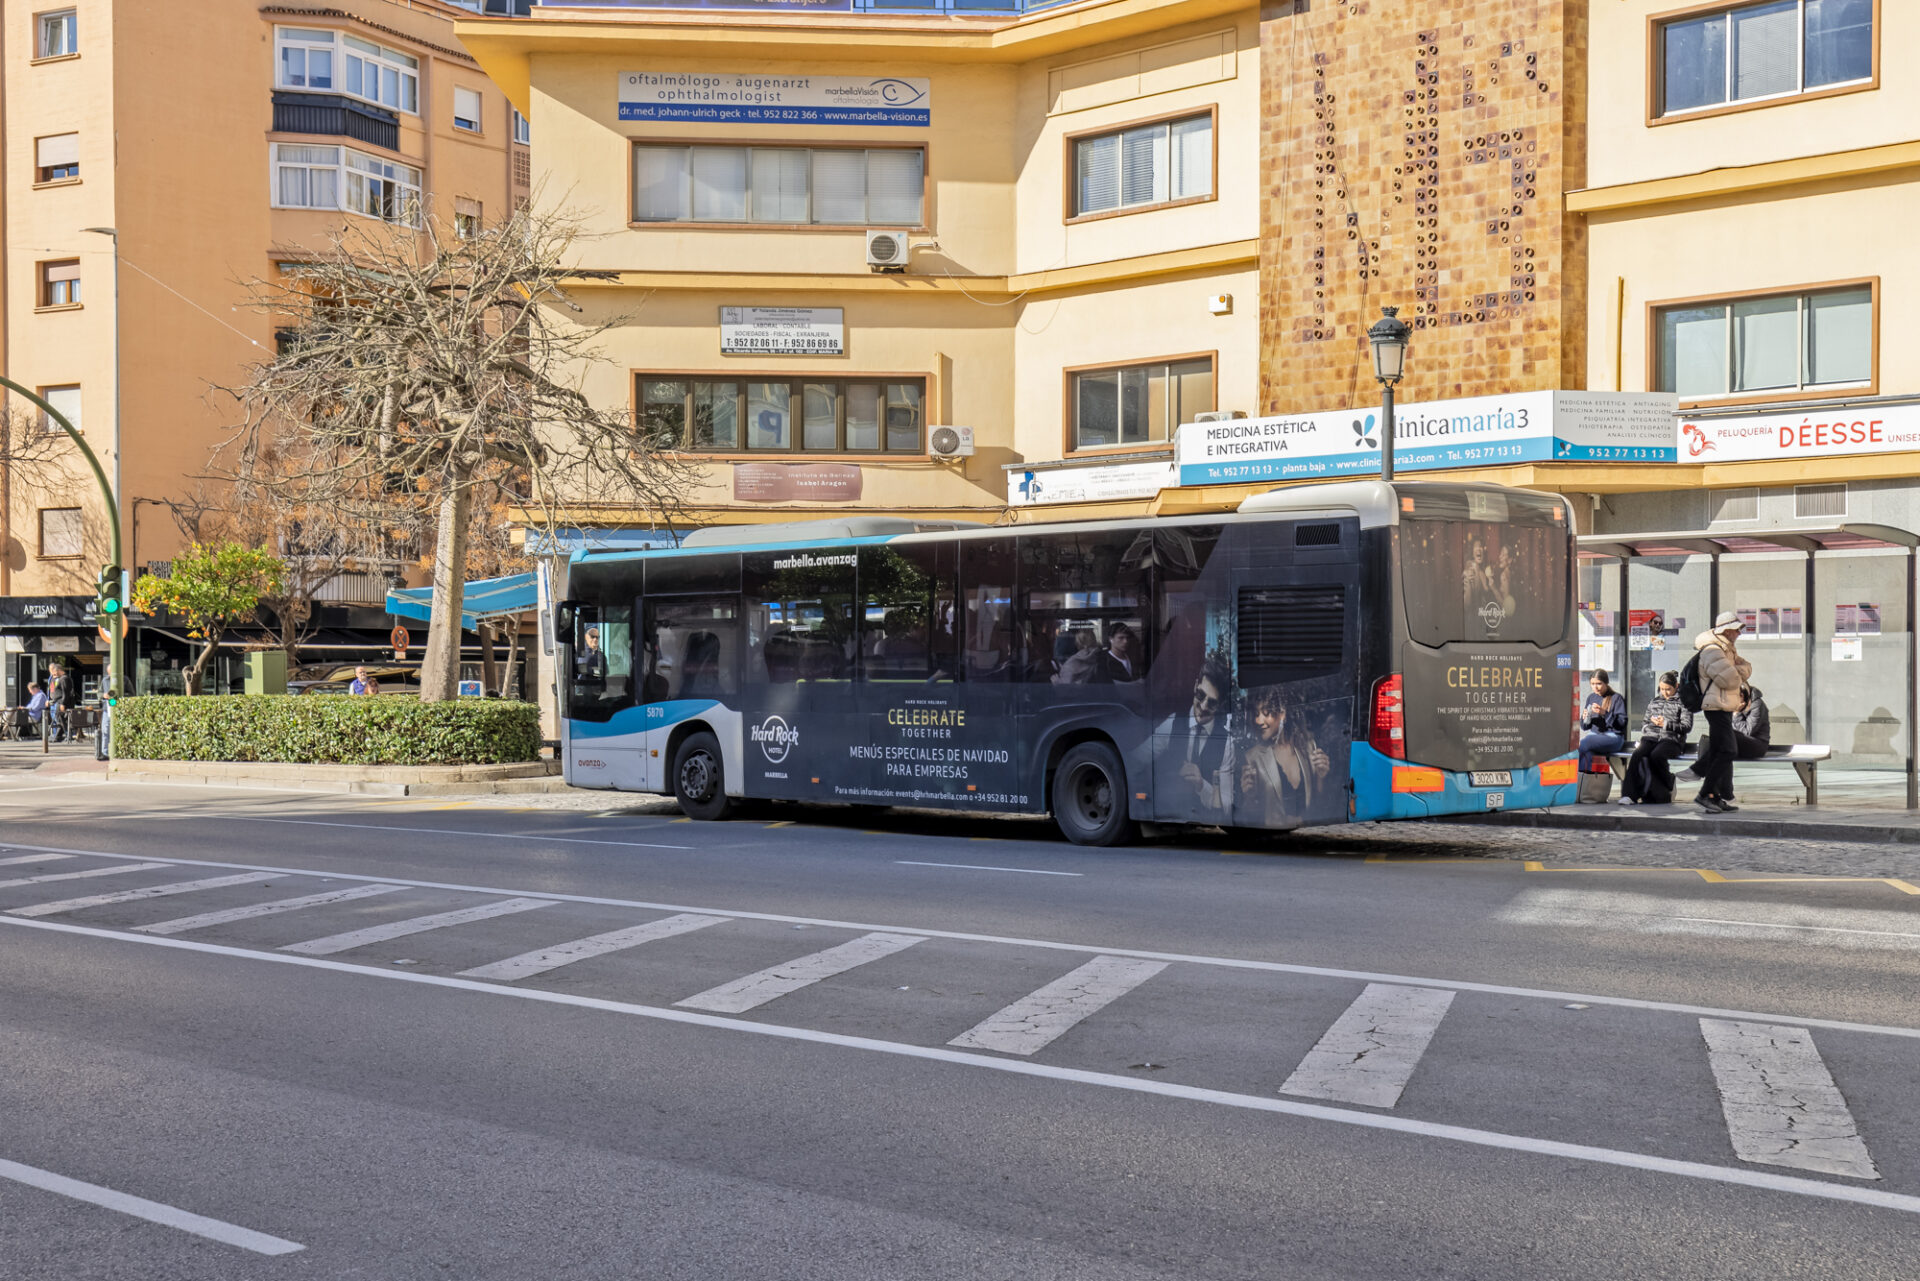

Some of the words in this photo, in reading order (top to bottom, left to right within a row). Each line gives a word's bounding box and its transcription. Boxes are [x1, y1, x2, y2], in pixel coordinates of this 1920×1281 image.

[629, 73, 721, 88] oftalmólogo
[736, 77, 810, 90] augenarzt
[658, 89, 781, 103] ophthalmologist
[620, 106, 632, 116] dr.
[634, 106, 655, 116] med.
[657, 106, 717, 118] johann-ulrich
[720, 108, 740, 120] geck
[748, 109, 762, 118] tel.
[763, 110, 781, 119] 952
[782, 110, 799, 119] 822
[801, 111, 817, 120] 366
[824, 112, 928, 122] www.marbella-vision.es
[734, 338, 749, 347] 952
[749, 338, 759, 347] 82
[760, 338, 770, 347] 06
[771, 339, 779, 347] 11
[791, 339, 805, 348] 952
[806, 339, 816, 348] 86
[817, 339, 827, 348] 69
[828, 340, 838, 348] 86
[1207, 425, 1261, 440] MEDICINA
[1264, 420, 1317, 436] ESTÉTICA
[1382, 407, 1529, 439] línicamaría3
[1717, 426, 1773, 438] PELUQUERÍA
[1779, 418, 1883, 448] DÉESSE
[1887, 433, 1920, 443] UNISE
[1207, 445, 1214, 456] E
[1216, 440, 1288, 456] INTEGRATIVA
[1588, 447, 1611, 457] 952
[1614, 448, 1628, 457] 77
[1633, 449, 1647, 458] 13
[1651, 449, 1665, 458] 13
[1208, 468, 1222, 478] Tel.
[1223, 466, 1237, 477] 952
[1239, 466, 1249, 476] 77
[1251, 465, 1261, 475] 13
[1263, 464, 1272, 474] 13
[1282, 463, 1307, 476] planta
[1309, 461, 1326, 473] baja
[1336, 454, 1435, 469] www.clinicaria3.com
[1446, 450, 1462, 461] Tel.
[1464, 449, 1481, 459] 952
[1483, 448, 1495, 458] 77
[1497, 446, 1508, 456] 13
[1511, 445, 1522, 455] 13
[773, 554, 857, 569] marbella.avanzag
[23, 604, 57, 615] ARTISAN
[1478, 607, 1492, 617] Hard
[1557, 657, 1572, 666] 5870
[1447, 666, 1543, 688] CELEBRATE
[1466, 691, 1527, 704] TOGETHER
[646, 707, 664, 718] 5870
[888, 708, 966, 727] CELEBRATE
[751, 725, 775, 742] Hard
[775, 725, 799, 746] Rock
[901, 728, 952, 739] TOGETHER
[850, 743, 883, 759] MENÚS
[885, 747, 944, 761] ESPECIALES
[947, 749, 960, 761] DE
[963, 749, 1009, 763] NAVIDAD
[578, 759, 601, 767] avanza
[886, 763, 912, 777] PARA
[915, 764, 968, 779] EMPRESAS
[1475, 773, 1494, 784] 3020
[834, 785, 848, 795] Para
[848, 787, 860, 795] más
[895, 789, 968, 801] events@hrhmarbella.com
[974, 793, 986, 802] +34
[986, 793, 999, 803] 952
[1000, 794, 1008, 803] 81
[1009, 794, 1018, 804] 20
[1019, 795, 1028, 805] 00
